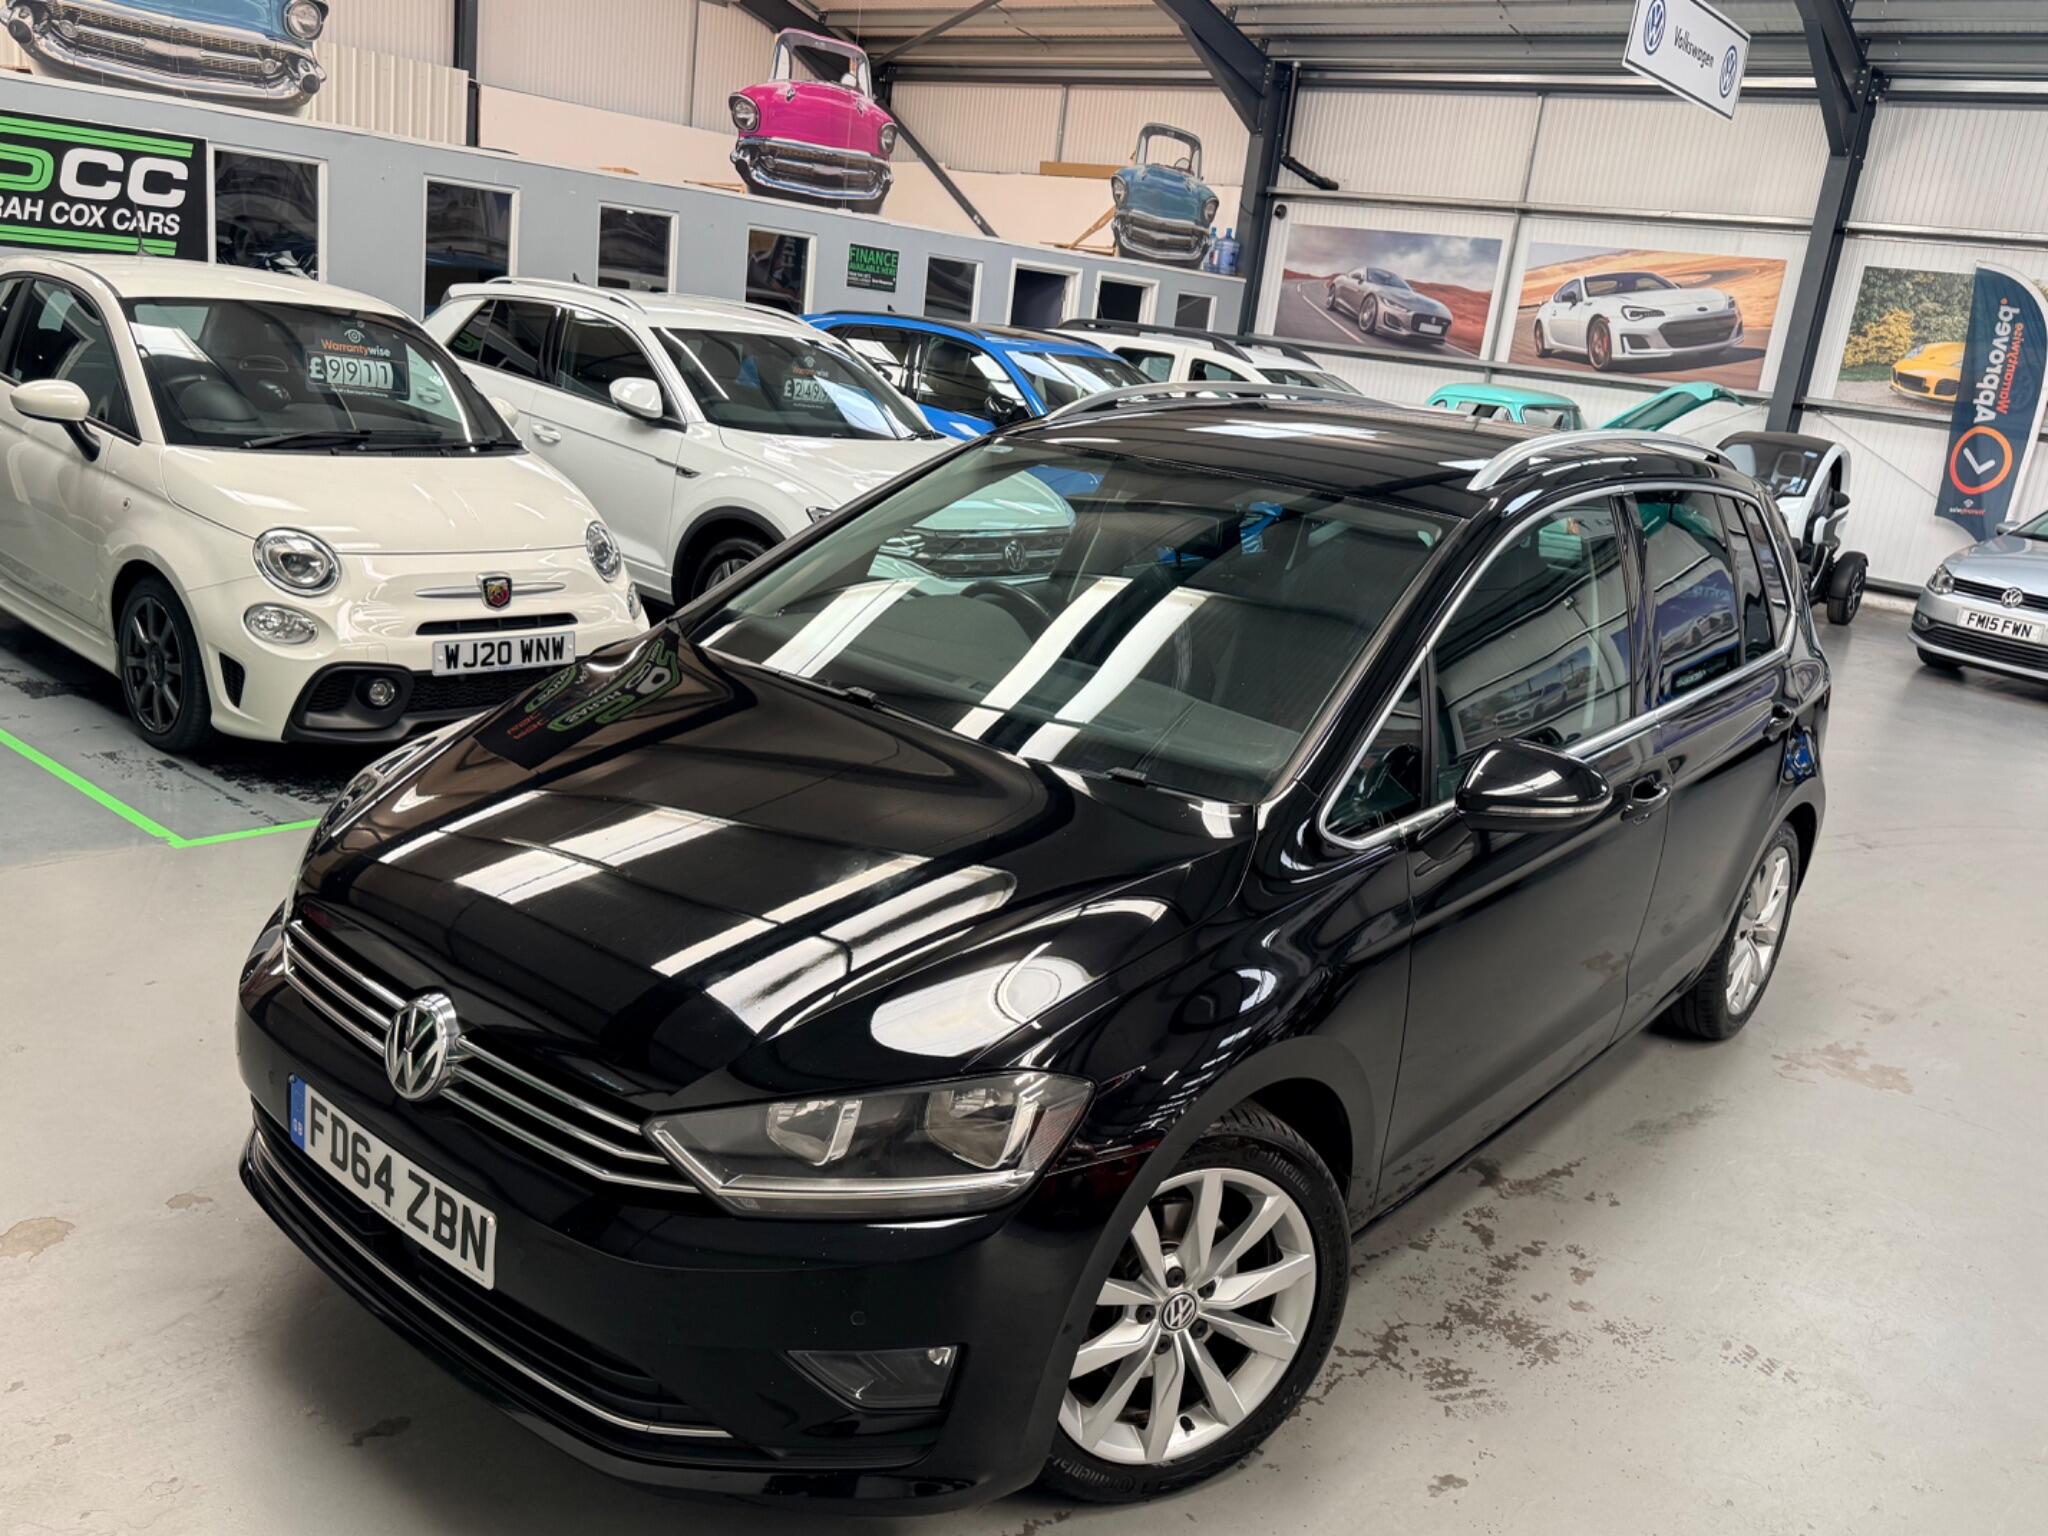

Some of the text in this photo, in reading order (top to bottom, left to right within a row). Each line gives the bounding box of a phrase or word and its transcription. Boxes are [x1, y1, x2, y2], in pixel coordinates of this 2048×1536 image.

[1674, 25, 1715, 69] Volkswagen
[0, 196, 181, 236] AH COX CARS
[849, 247, 898, 268] FINANCE
[321, 339, 391, 357] Warrantywise
[1967, 612, 2032, 638] FM15 FWN
[445, 636, 565, 670] WJ20 WNW
[310, 1096, 487, 1273] FD64 ZBN
